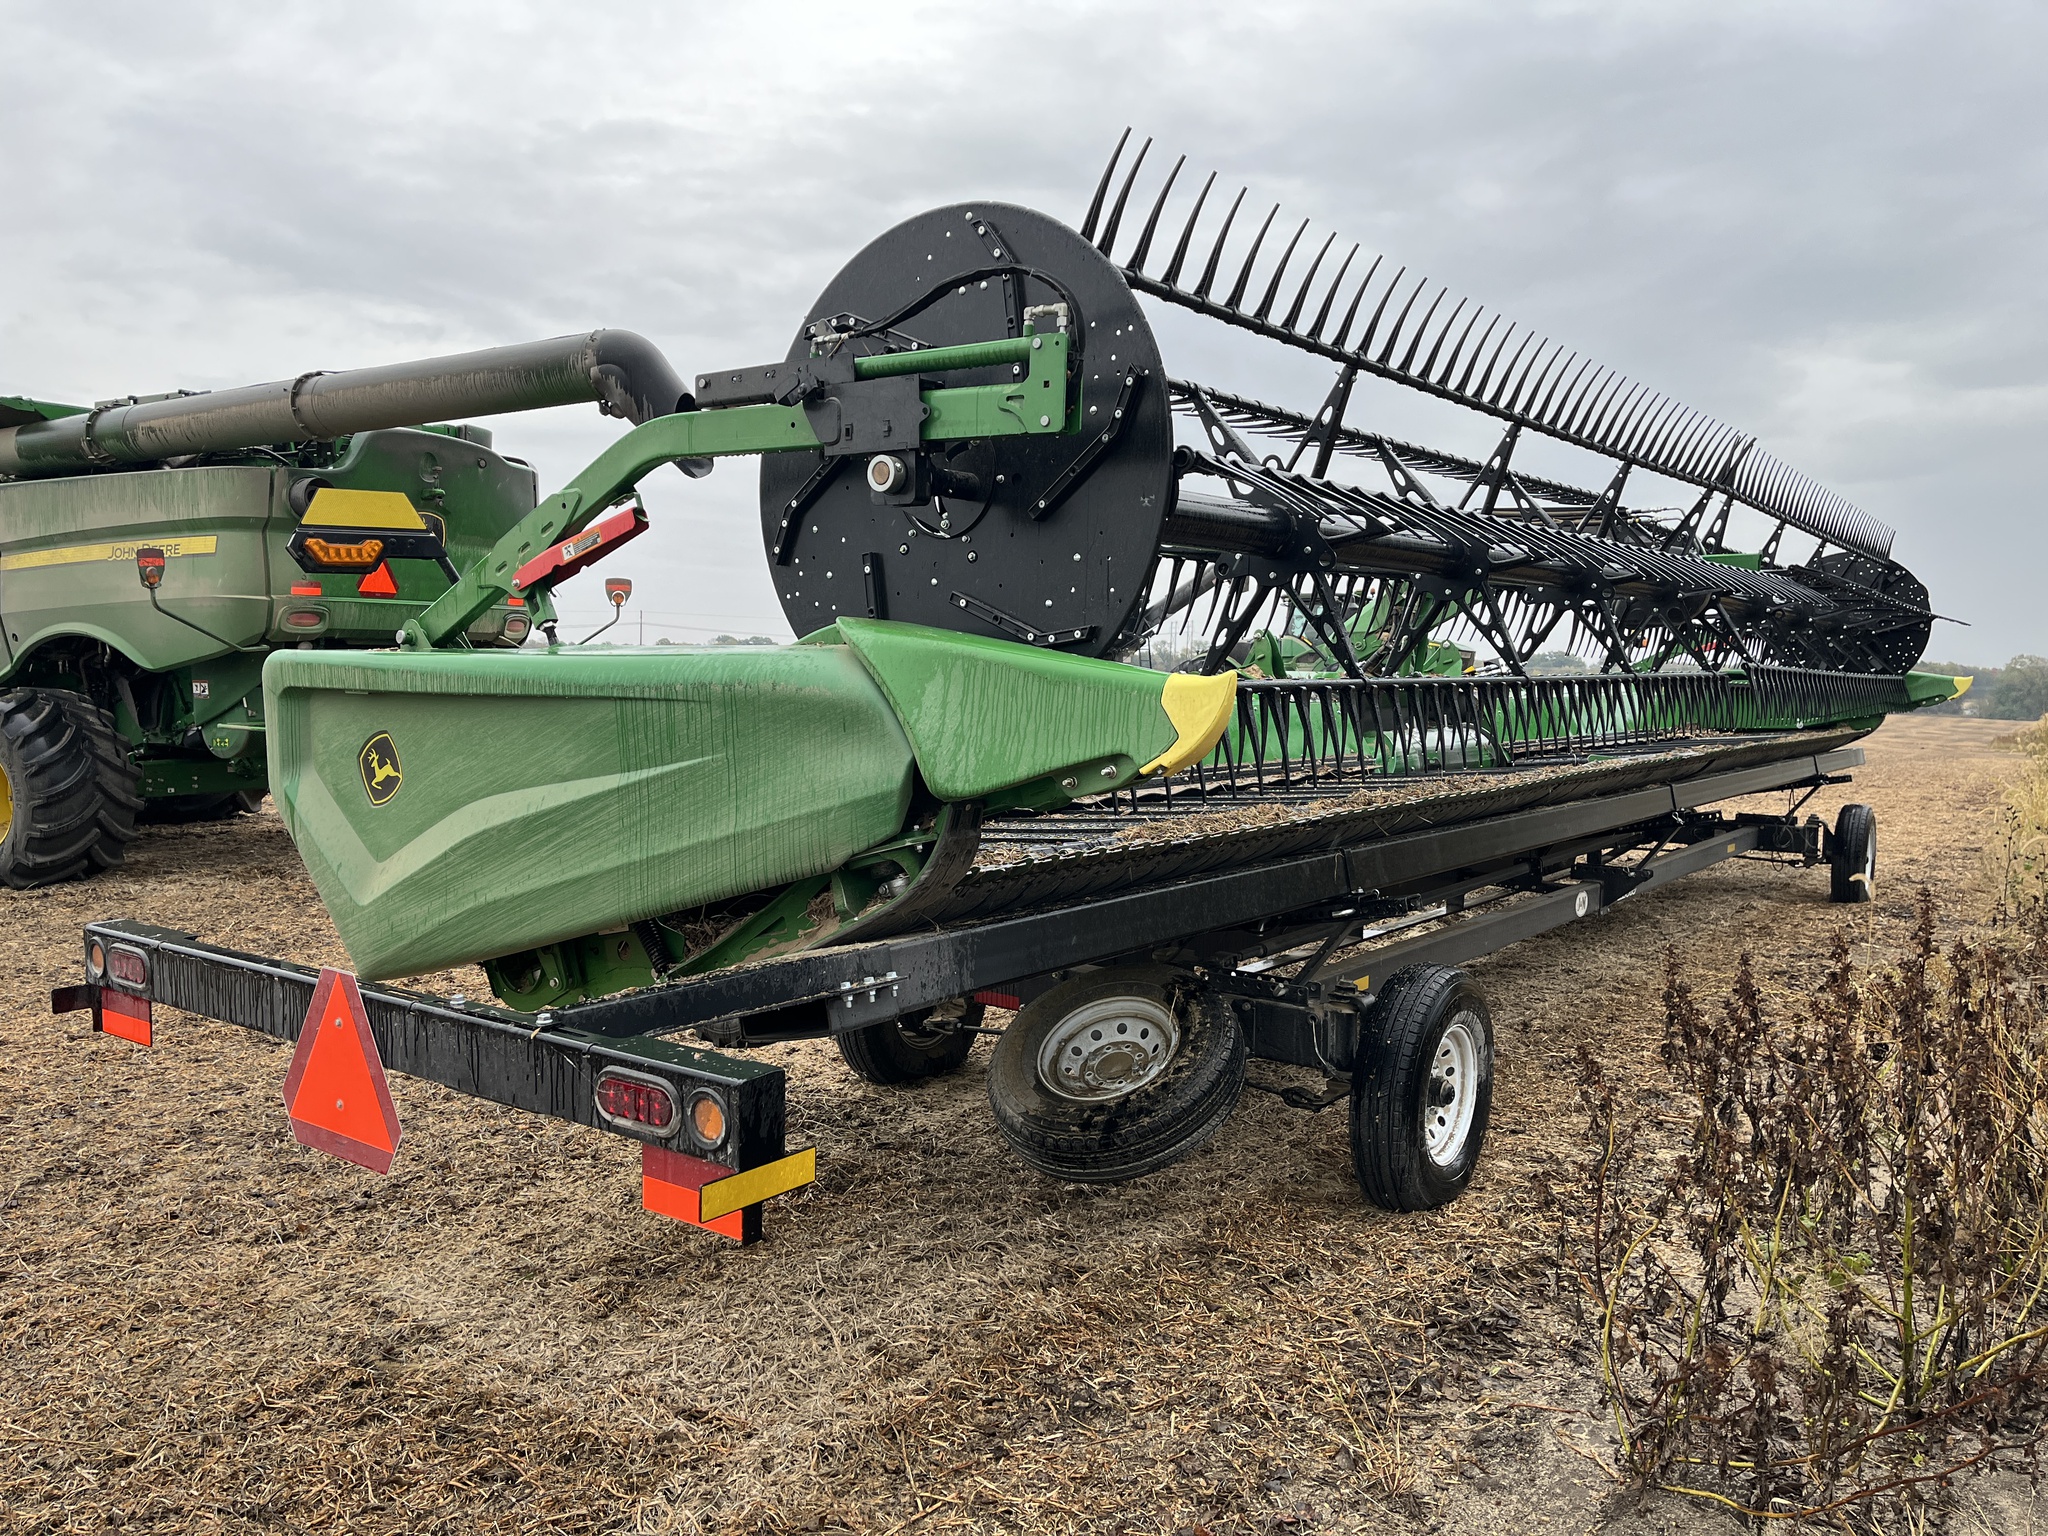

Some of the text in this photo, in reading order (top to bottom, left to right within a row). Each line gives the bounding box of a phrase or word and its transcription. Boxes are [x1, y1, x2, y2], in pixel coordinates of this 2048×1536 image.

[738, 374, 743, 383] 3
[771, 369, 776, 378] 2
[108, 546, 138, 559] JOHN
